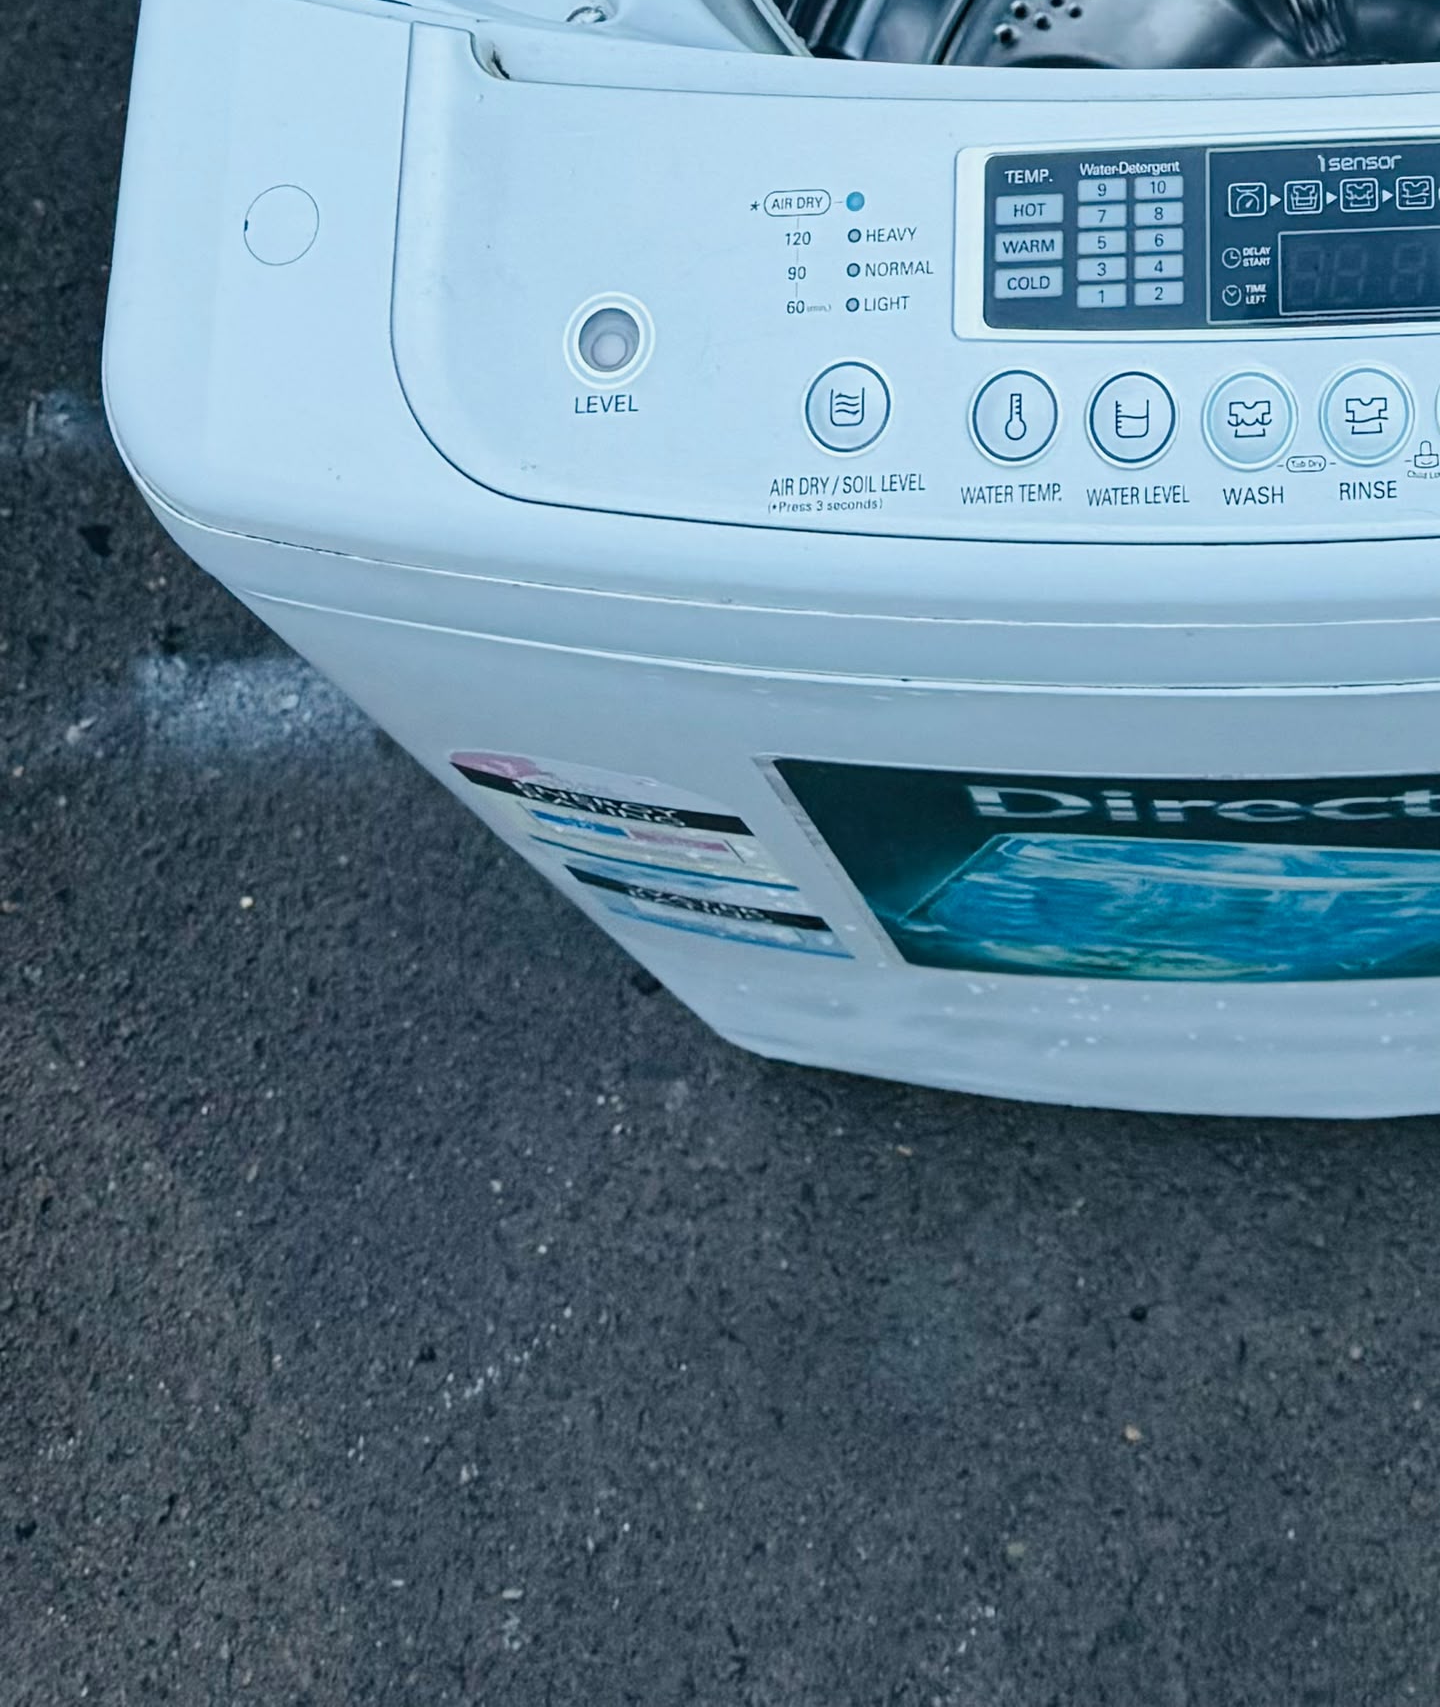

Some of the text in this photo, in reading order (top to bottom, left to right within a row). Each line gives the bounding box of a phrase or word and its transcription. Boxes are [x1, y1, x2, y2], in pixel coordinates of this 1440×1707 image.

[1004, 169, 1053, 184] TEMP.
[1097, 183, 1107, 197] 9
[1150, 181, 1166, 194] 10
[771, 196, 823, 211] AIR DRY
[1013, 203, 1047, 218] HOT
[1097, 210, 1107, 223] 7
[1154, 207, 1164, 220] 8
[785, 231, 811, 245] 120
[866, 227, 917, 243] HEAVY
[1154, 233, 1164, 247] 6
[1002, 239, 1055, 254] WARM
[1097, 236, 1107, 249] 5
[1243, 247, 1271, 257] DELAY
[1154, 259, 1163, 273] 4
[1242, 256, 1271, 267] START
[787, 266, 807, 280] 90
[865, 261, 934, 277] NORMAL
[1097, 262, 1107, 276] 3
[1007, 275, 1050, 291] COLD
[1245, 284, 1267, 294] TIME
[1098, 290, 1105, 303] 1
[1154, 287, 1164, 301] 2
[1245, 294, 1267, 305] LEFT
[786, 300, 805, 315] 60
[864, 295, 910, 312] LIGHT
[575, 394, 639, 414] LEVEL
[1308, 459, 1322, 469] Dry
[769, 477, 795, 497] AIR
[799, 476, 830, 496] DRY
[842, 474, 877, 495] SOIL
[881, 473, 926, 492] LEVEL
[1339, 480, 1398, 501] RINSE
[960, 483, 1063, 505] WATER TEMP.
[1086, 485, 1190, 507] WATER LEVEL
[1223, 485, 1285, 506] WASH
[816, 500, 824, 512] 3
[827, 498, 883, 512] seconds)
